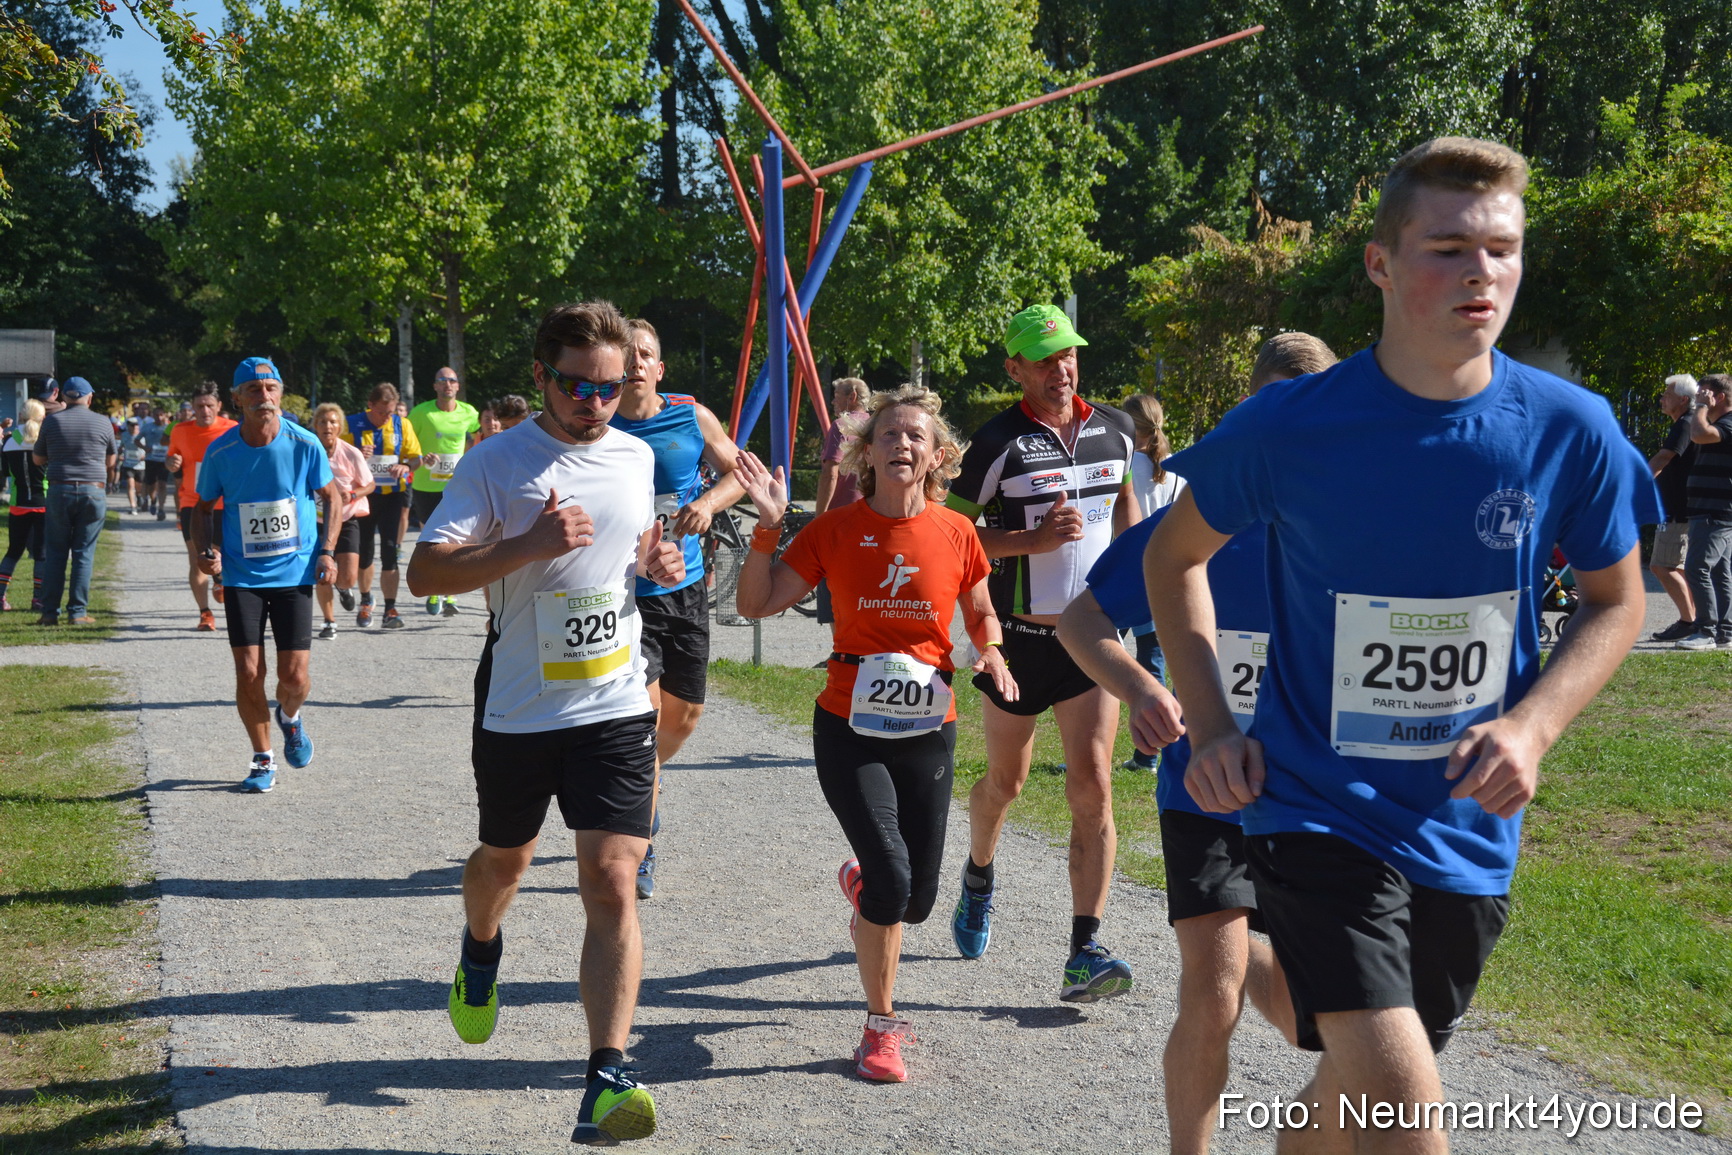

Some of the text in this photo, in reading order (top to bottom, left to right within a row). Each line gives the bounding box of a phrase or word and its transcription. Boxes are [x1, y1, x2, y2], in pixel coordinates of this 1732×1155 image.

[1085, 467, 1115, 480] ROCK
[249, 515, 291, 535] 2139
[254, 541, 291, 552] Karl-Heinz
[568, 592, 613, 609] BOCK
[857, 597, 932, 611] funrunners
[880, 609, 940, 621] neumarkt
[1390, 612, 1470, 631] BOCK
[565, 610, 617, 648] 329
[563, 645, 614, 658] PARTL Neumarkt
[1361, 640, 1488, 692] 2590
[1343, 677, 1351, 686] D
[868, 679, 934, 707] 2201
[872, 706, 893, 714] PARTL
[1372, 698, 1463, 710] PARTL Neumarkt
[883, 718, 915, 732] Helga
